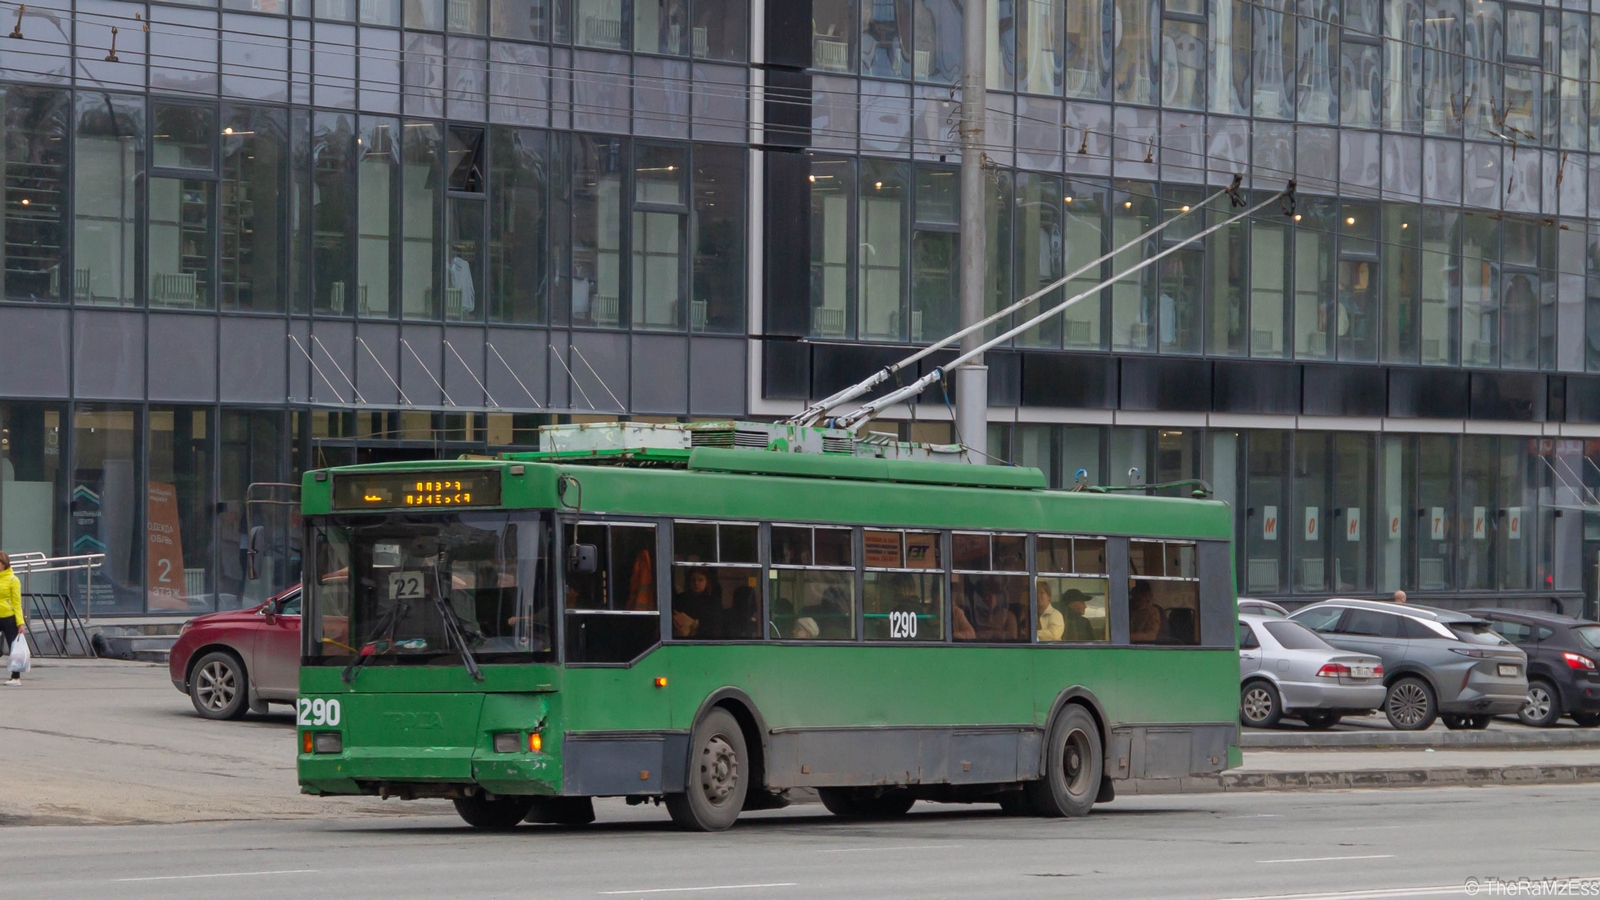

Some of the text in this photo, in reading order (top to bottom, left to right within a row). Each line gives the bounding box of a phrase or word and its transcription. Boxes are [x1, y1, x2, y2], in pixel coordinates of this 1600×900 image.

[148, 521, 174, 534] ОДЕЖДА
[150, 534, 173, 545] ОБУВЬ
[157, 558, 172, 583] 2
[152, 586, 181, 598] этаж
[394, 577, 420, 597] 22
[889, 611, 917, 638] 1290
[296, 698, 341, 726] 1290
